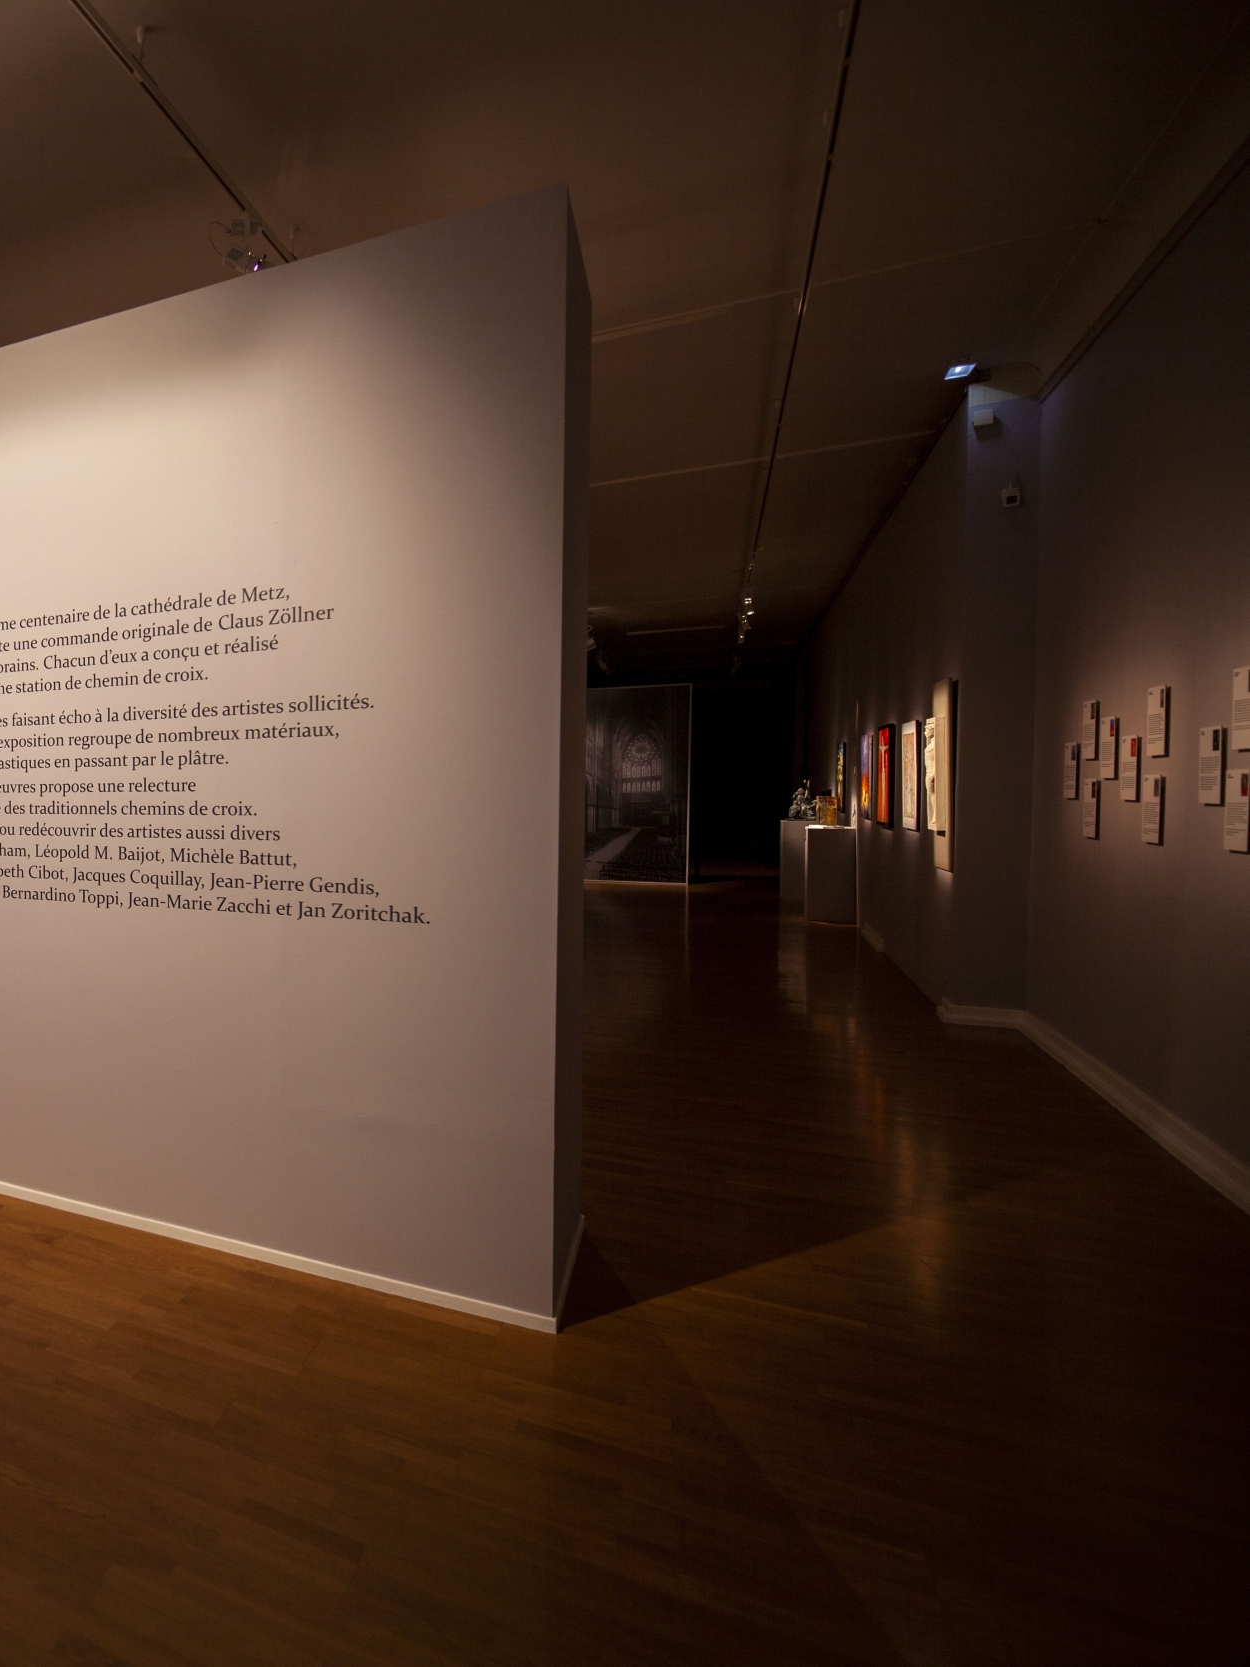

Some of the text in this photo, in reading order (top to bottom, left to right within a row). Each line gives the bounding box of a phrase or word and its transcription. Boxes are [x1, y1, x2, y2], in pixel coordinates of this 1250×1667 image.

[19, 608, 90, 628] centenaire
[92, 604, 111, 620] de
[114, 602, 128, 617] la
[130, 592, 213, 615] cathédrale
[216, 589, 237, 606] de
[241, 586, 290, 603] Metz,
[12, 638, 38, 650] une
[40, 626, 119, 648] commande
[121, 618, 190, 642] originale
[193, 616, 213, 632] de
[218, 612, 264, 630] Claus
[268, 605, 335, 625] Zöllner
[15, 677, 62, 693] station
[64, 674, 82, 690] de
[84, 671, 139, 688] chemin
[142, 668, 162, 684] de
[164, 665, 209, 682] croix.
[11, 711, 56, 726] faisant
[58, 708, 92, 724] écho
[94, 708, 103, 722] à
[106, 706, 120, 722] la
[122, 703, 188, 721] diversité
[190, 701, 219, 717] des
[221, 699, 285, 716] artistes
[288, 692, 375, 713] sollicités.
[67, 733, 132, 750] regroupe
[135, 728, 154, 743] de
[157, 725, 241, 742] nombreux
[244, 721, 340, 739] matériaux,
[39, 782, 95, 797] propose
[97, 782, 125, 792] une
[128, 776, 197, 792] relecture
[3, 800, 26, 814] des
[28, 799, 118, 815] traditionnels
[120, 799, 185, 815] chemins
[188, 799, 209, 815] de
[211, 800, 258, 816] croix.
[18, 821, 97, 837] redécouvrir
[99, 822, 124, 837] des
[126, 823, 183, 839] artistes
[185, 824, 226, 840] aussi
[229, 824, 281, 841] divers
[34, 843, 90, 862] Léopold
[94, 845, 113, 860] M.
[117, 845, 165, 865] Baijot,
[169, 847, 235, 864] Michèle
[238, 849, 297, 869] Battut,
[28, 864, 69, 882] Cibot,
[71, 866, 126, 886] Jacques
[129, 868, 205, 891] Coquillay,
[209, 872, 305, 891] Jean-Pierre
[308, 876, 380, 898] Gendis,
[2, 884, 76, 902] Bernardino
[78, 888, 124, 909] Toppi,
[126, 891, 213, 911] Jean-Marie
[216, 896, 272, 914] Zacchi
[275, 902, 293, 916] et
[296, 900, 327, 920] Jan
[331, 902, 431, 924] Zoritchak.
